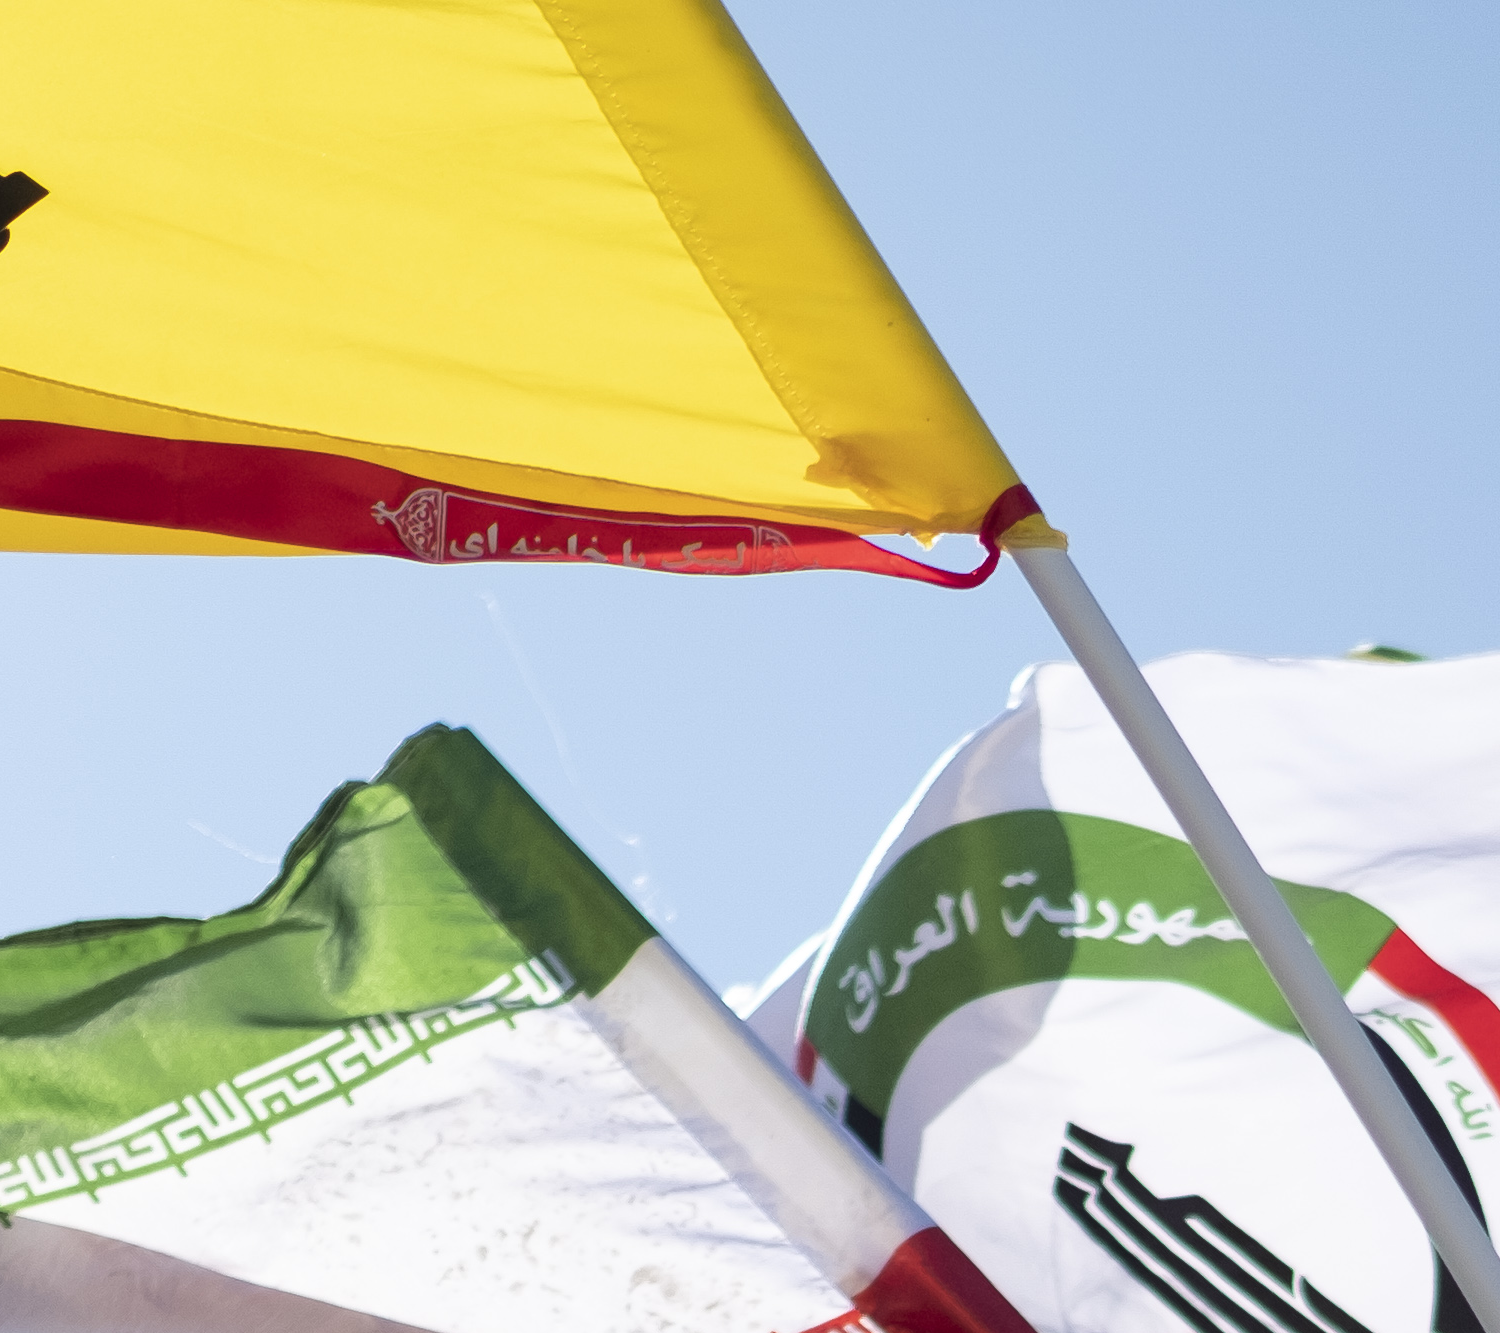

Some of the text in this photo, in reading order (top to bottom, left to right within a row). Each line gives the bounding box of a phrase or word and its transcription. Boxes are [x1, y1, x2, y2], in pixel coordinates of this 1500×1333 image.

[449, 521, 499, 560] ای
[837, 868, 1314, 1034] مهورية العراق
[1445, 1080, 1494, 1140] الله
